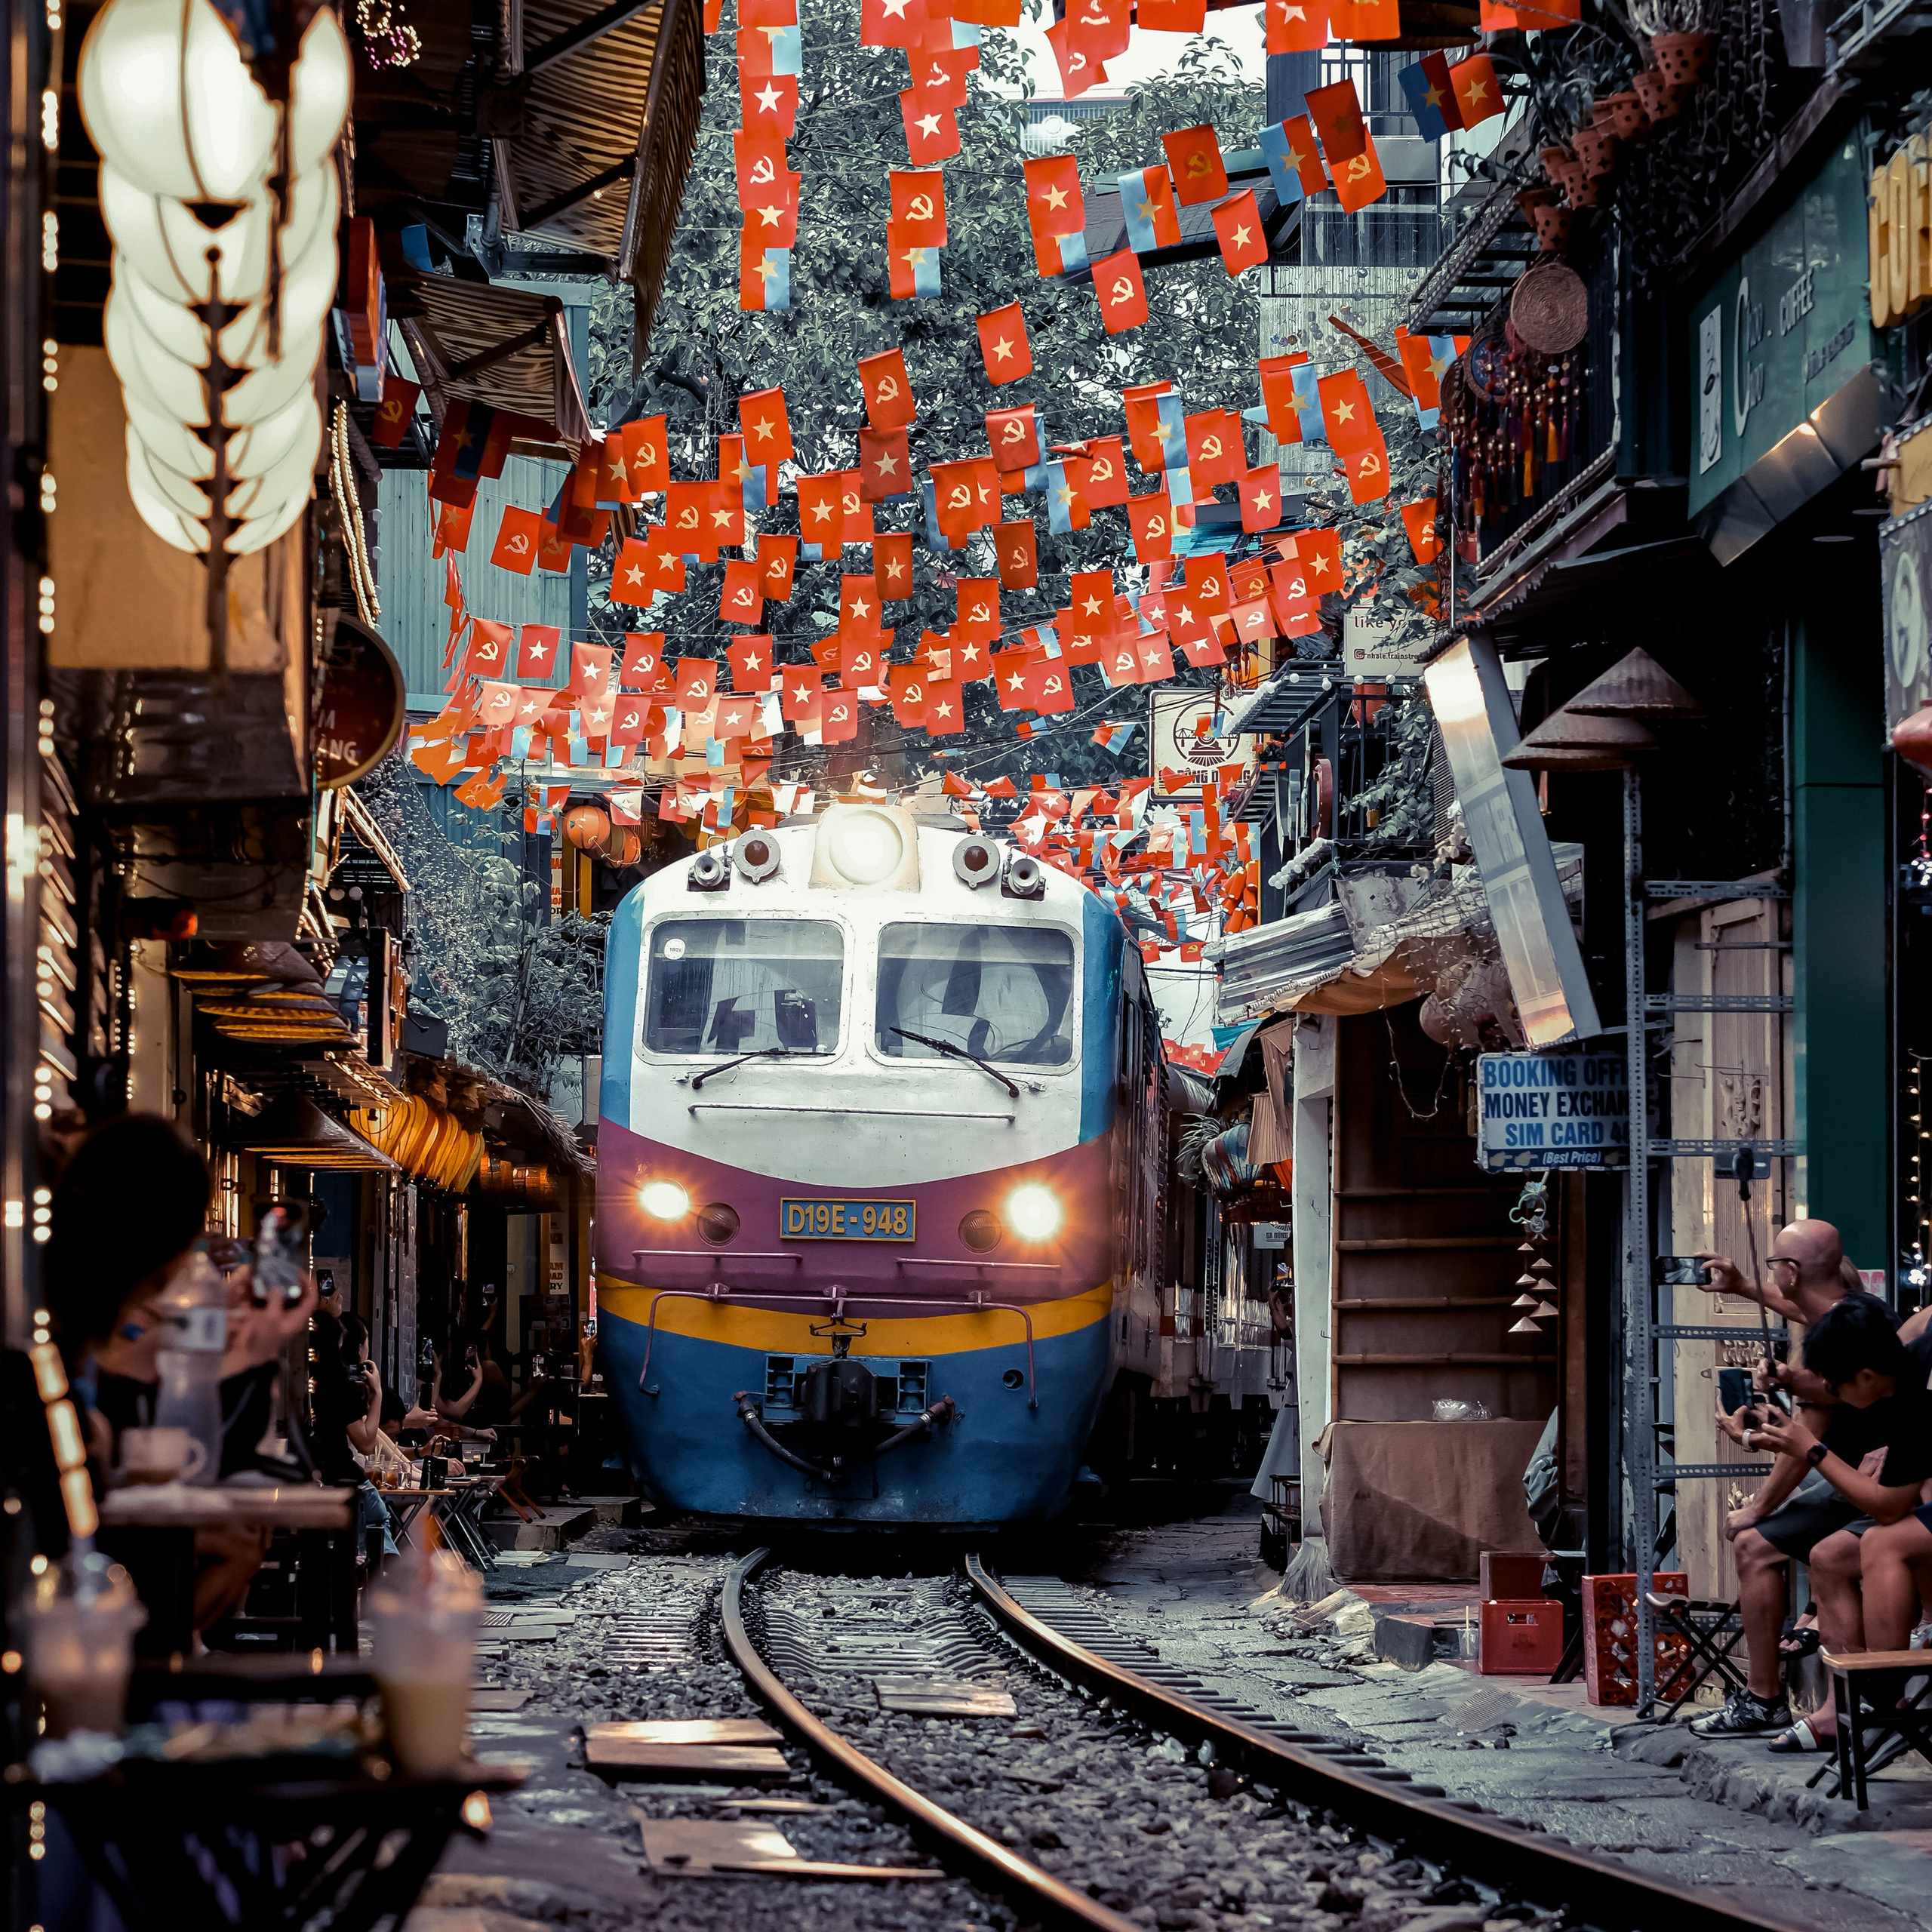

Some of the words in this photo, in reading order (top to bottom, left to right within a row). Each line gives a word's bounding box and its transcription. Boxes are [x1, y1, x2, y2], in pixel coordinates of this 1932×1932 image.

[1780, 267, 1815, 337] COFFEE
[1484, 1057, 1577, 1088] BOOKING
[1484, 1092, 1550, 1118] MONEY
[1557, 1090, 1655, 1117] EXCHANE
[1506, 1122, 1544, 1147] SIM
[1551, 1121, 1604, 1146] CARD
[1543, 1152, 1570, 1164] (Best
[1571, 1151, 1602, 1164] Price)
